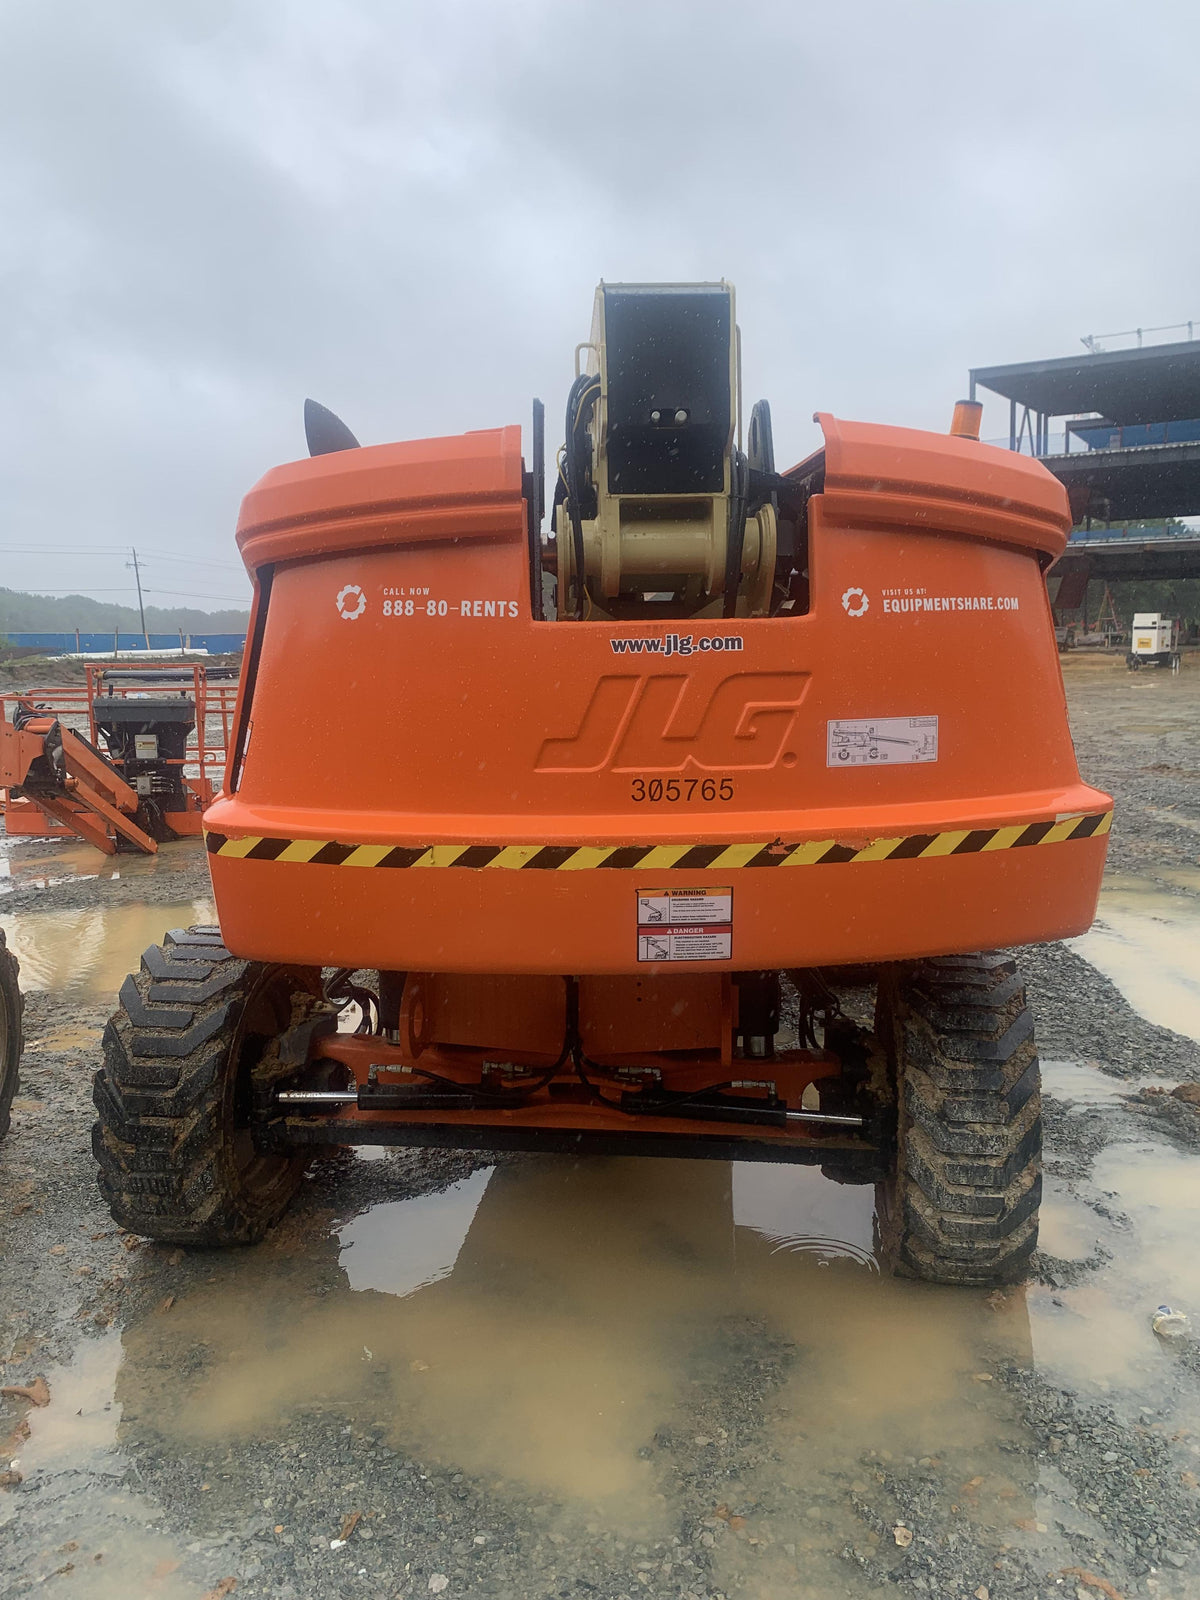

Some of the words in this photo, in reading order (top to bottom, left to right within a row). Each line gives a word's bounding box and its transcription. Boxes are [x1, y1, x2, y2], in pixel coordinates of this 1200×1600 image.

[383, 587, 405, 596] CALL
[409, 587, 430, 596] NOW
[904, 588, 914, 596] US
[382, 599, 519, 618] 888-80-RENTS
[882, 596, 1020, 613] EQUIPMENTSHARE.COM
[610, 634, 744, 657] www.jlg.com
[534, 671, 812, 773] JLG
[631, 778, 734, 802] 305765
